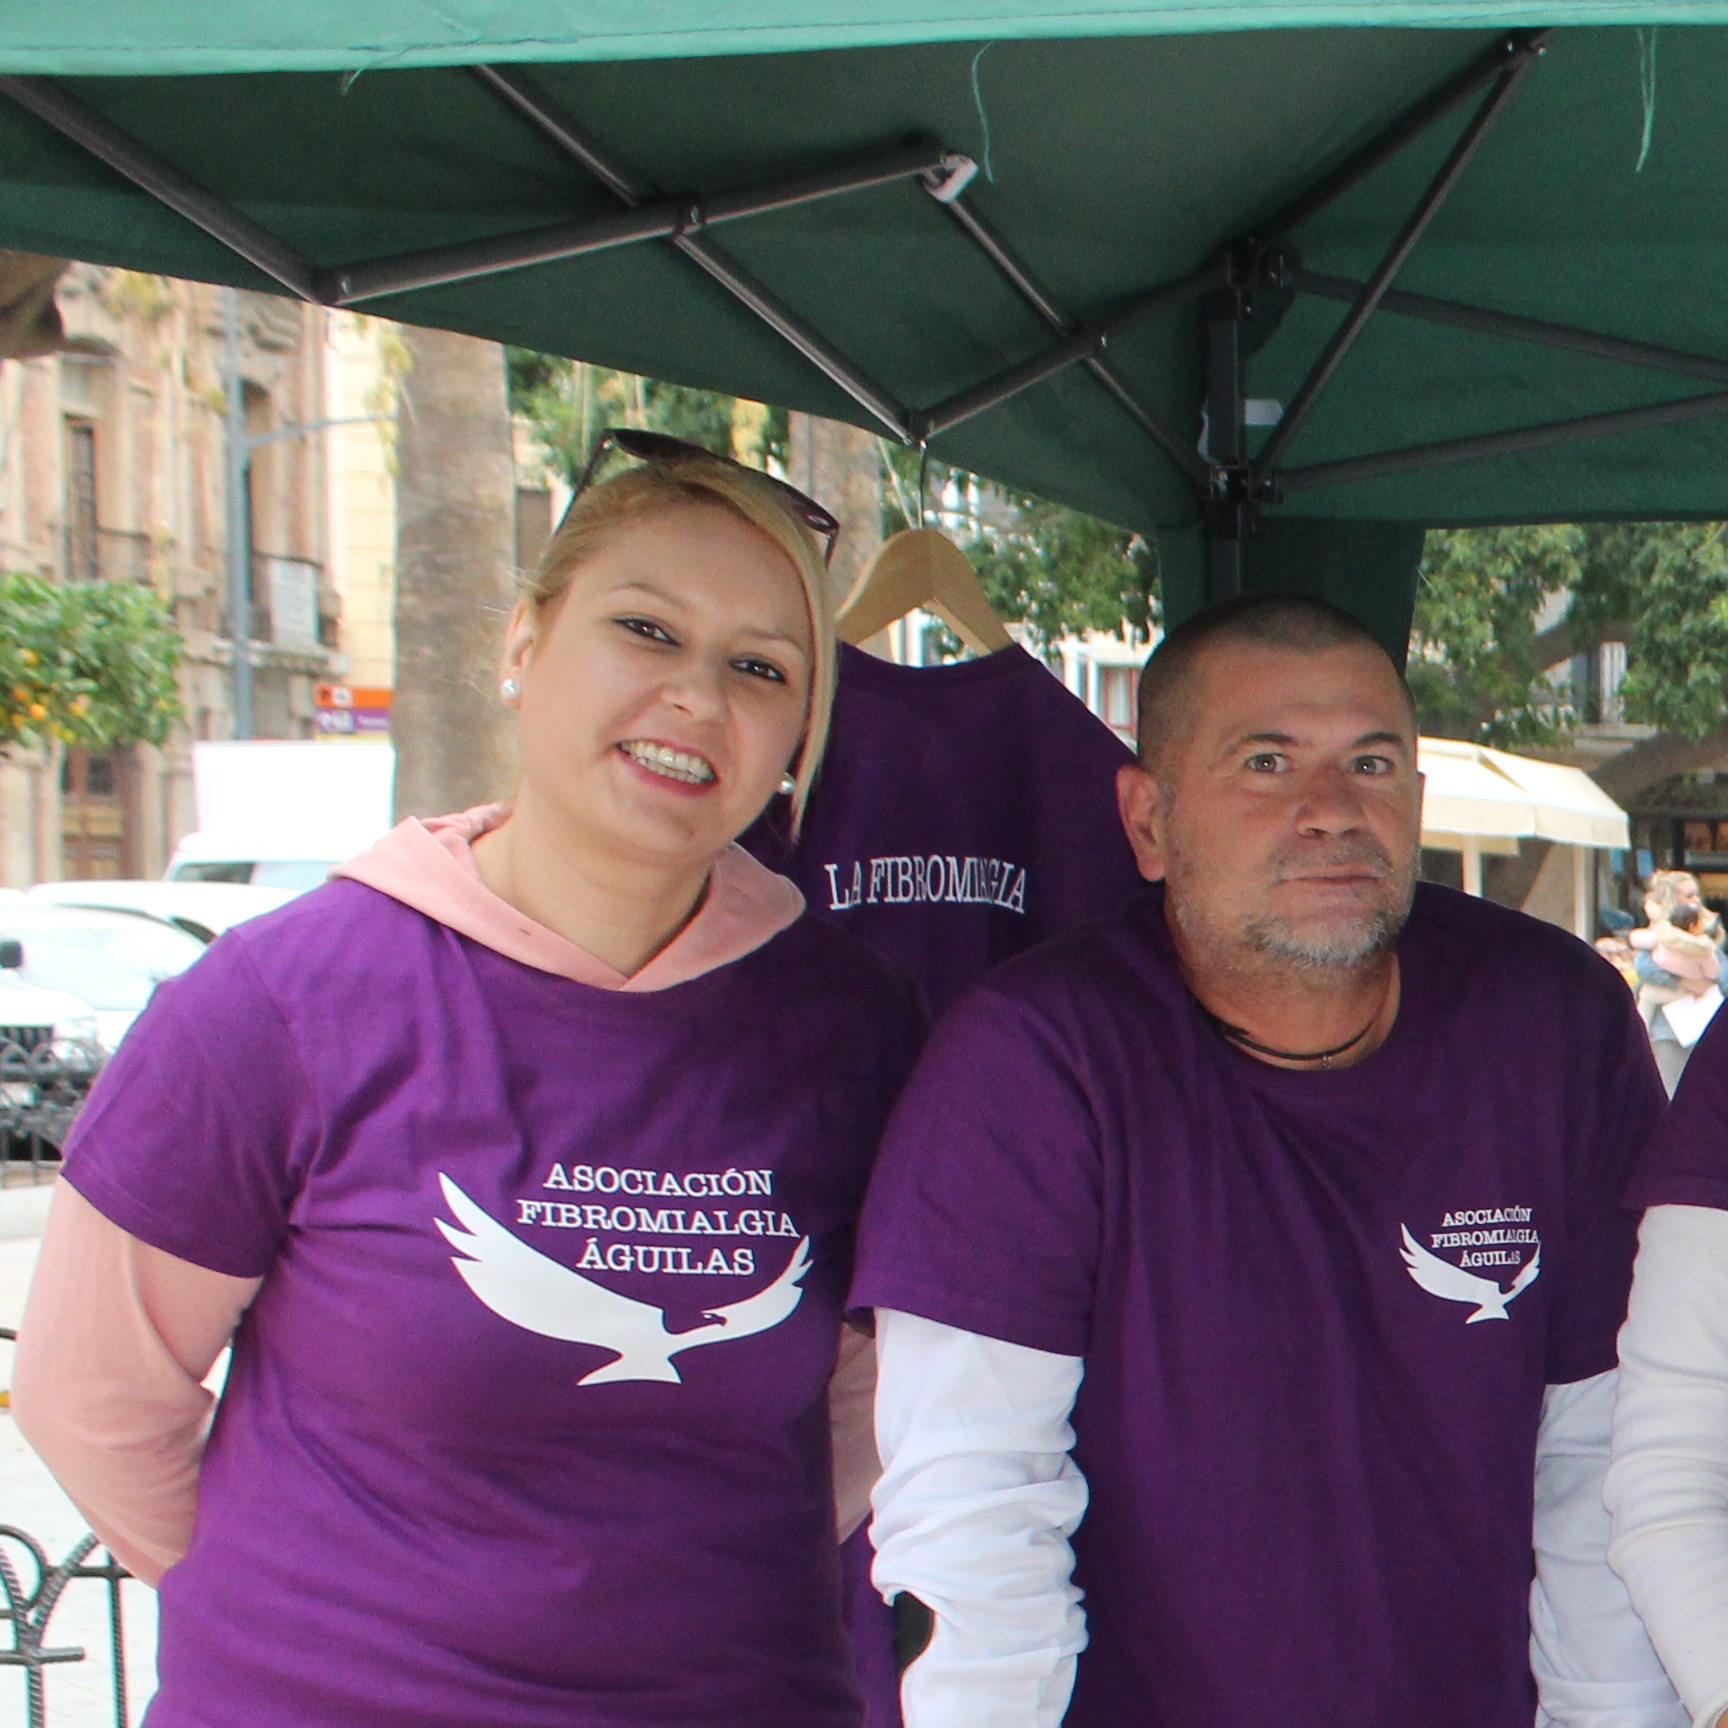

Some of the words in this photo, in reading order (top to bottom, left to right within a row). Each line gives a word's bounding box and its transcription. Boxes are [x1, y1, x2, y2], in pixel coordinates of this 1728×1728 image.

[823, 861, 862, 911] LA
[542, 1161, 774, 1198] ASOCIACIÓN
[515, 1198, 803, 1239] FIBROMIALGIA
[1441, 1205, 1533, 1227] ASOCIACIÓN
[575, 1237, 757, 1276] ÁGUILAS
[1430, 1229, 1541, 1249] FIBROMIALGIA
[1459, 1250, 1521, 1268] ÁGUILAS
